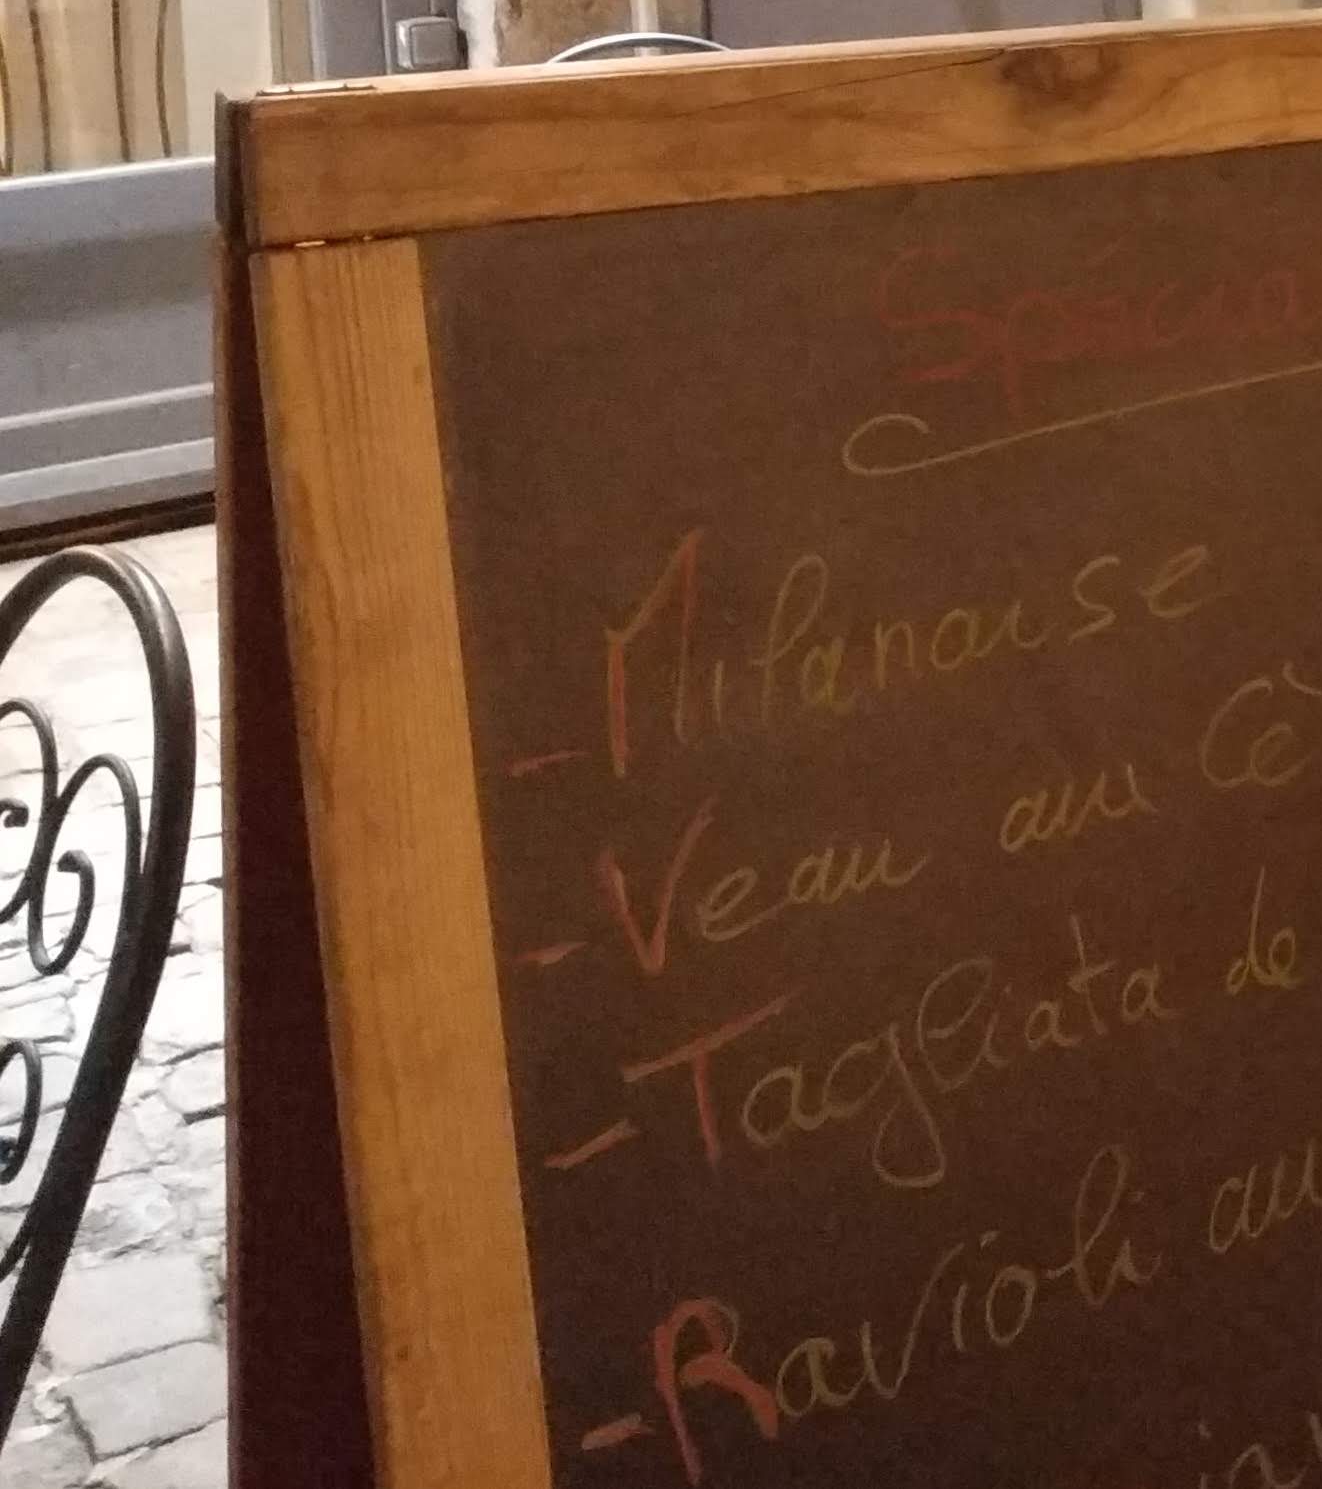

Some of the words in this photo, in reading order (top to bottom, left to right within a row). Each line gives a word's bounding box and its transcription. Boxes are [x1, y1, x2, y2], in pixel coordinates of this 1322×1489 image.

[600, 799, 932, 975] Veau
[620, 916, 1176, 1189] Tagliata
[1225, 868, 1302, 993] de
[652, 1143, 1162, 1483] Ravioli
